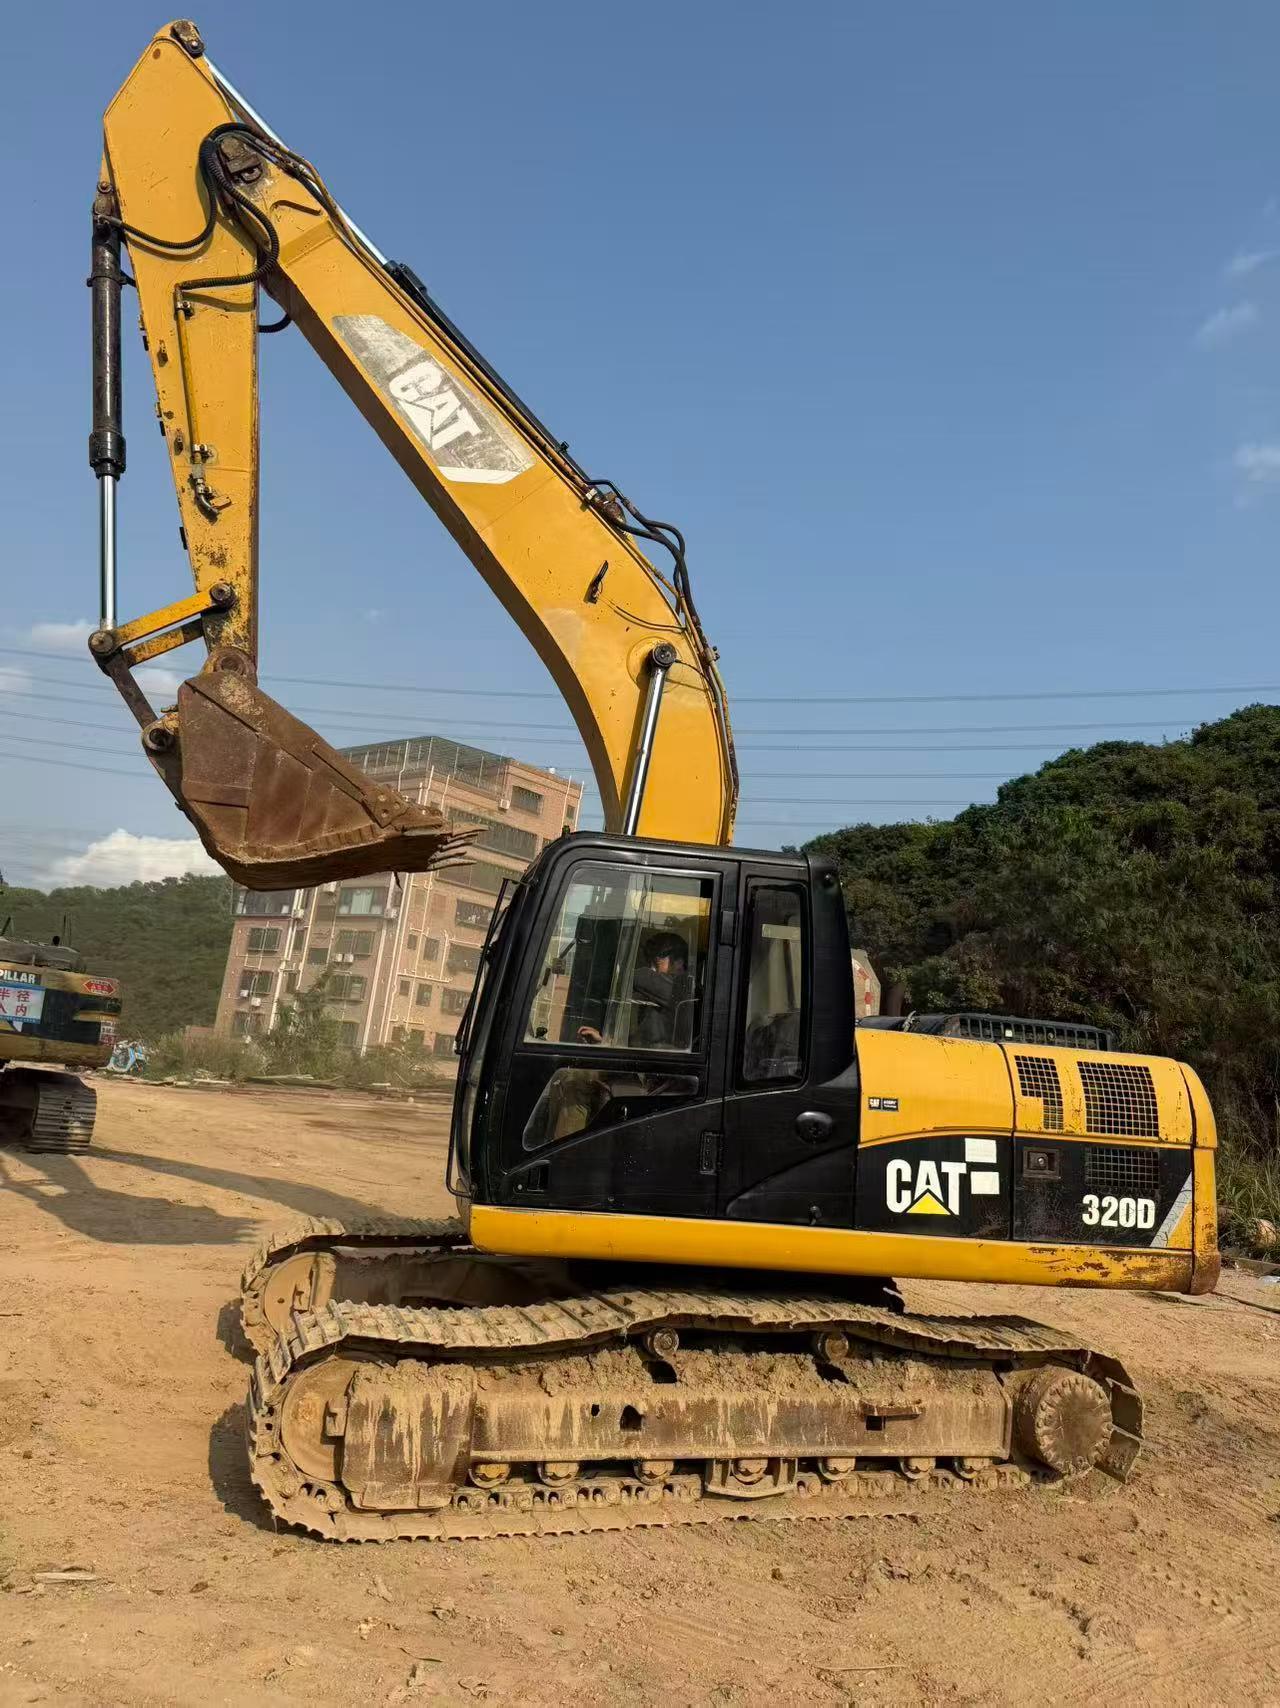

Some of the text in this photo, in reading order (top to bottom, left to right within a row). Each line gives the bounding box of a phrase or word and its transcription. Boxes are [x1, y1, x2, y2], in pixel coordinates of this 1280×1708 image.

[389, 360, 482, 451] CAT
[886, 1159, 967, 1215] CAT
[1082, 1194, 1155, 1229] 320D
